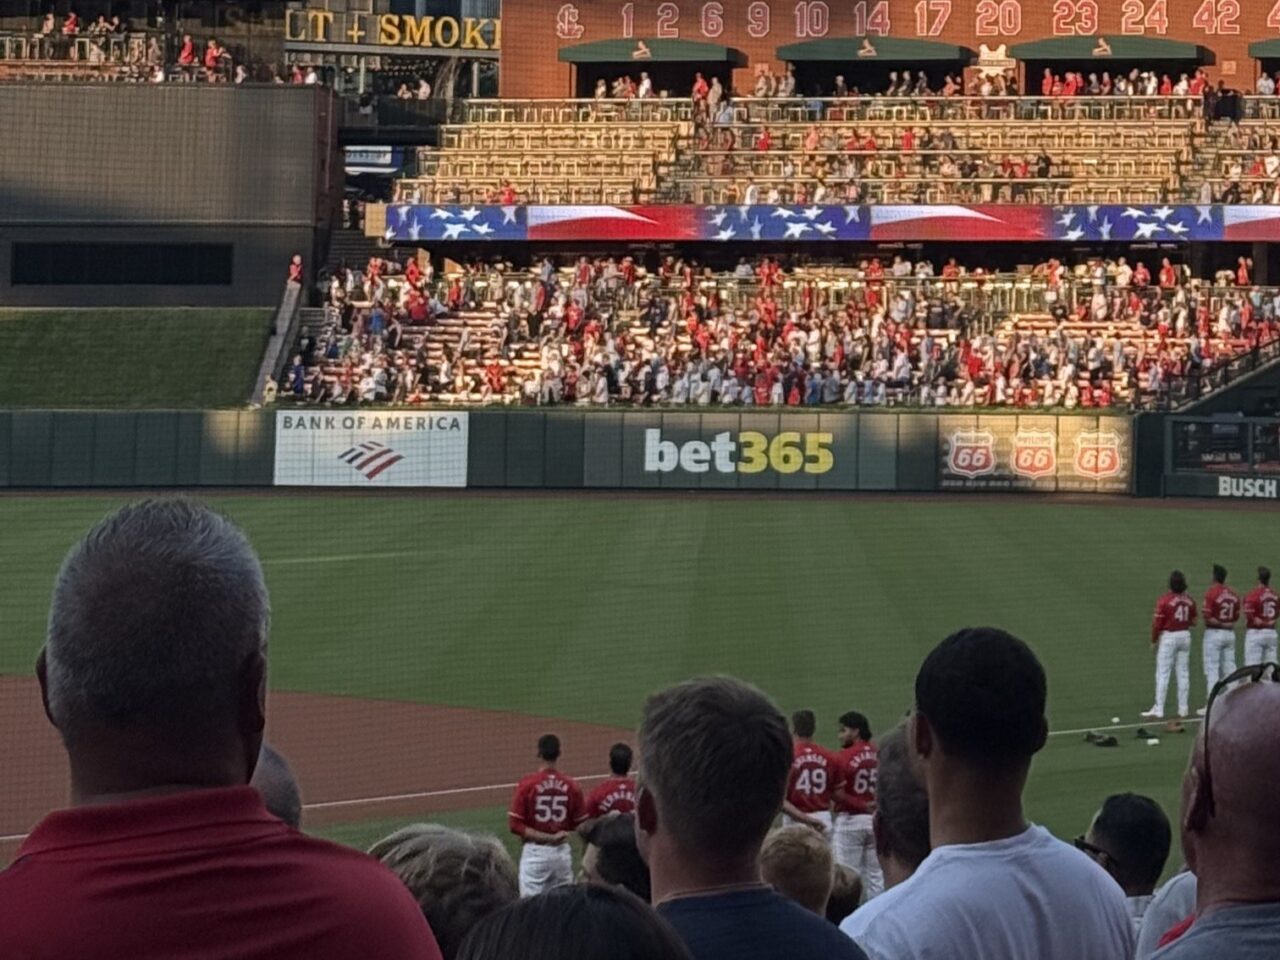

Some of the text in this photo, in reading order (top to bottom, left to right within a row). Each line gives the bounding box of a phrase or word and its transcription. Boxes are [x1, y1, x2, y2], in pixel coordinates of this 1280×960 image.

[621, 3, 634, 38] 1
[656, 2, 679, 38] 2
[701, 2, 724, 37] 6
[747, 1, 770, 37] 9
[794, 1, 829, 37] 10
[853, 0, 891, 36] 14
[914, 0, 952, 36] 17
[975, 0, 1021, 36] 20
[1052, 0, 1099, 35] 23
[283, 415, 461, 431] BANK OF AMERICA
[644, 427, 834, 475] bet365
[957, 449, 987, 467] 66
[1018, 449, 1049, 467] 66
[1082, 450, 1112, 468] 66
[1218, 476, 1277, 499] BUSCH
[1174, 605, 1189, 621] 41
[1220, 602, 1234, 619] 21
[795, 768, 827, 794] 49
[535, 795, 568, 822] 55
